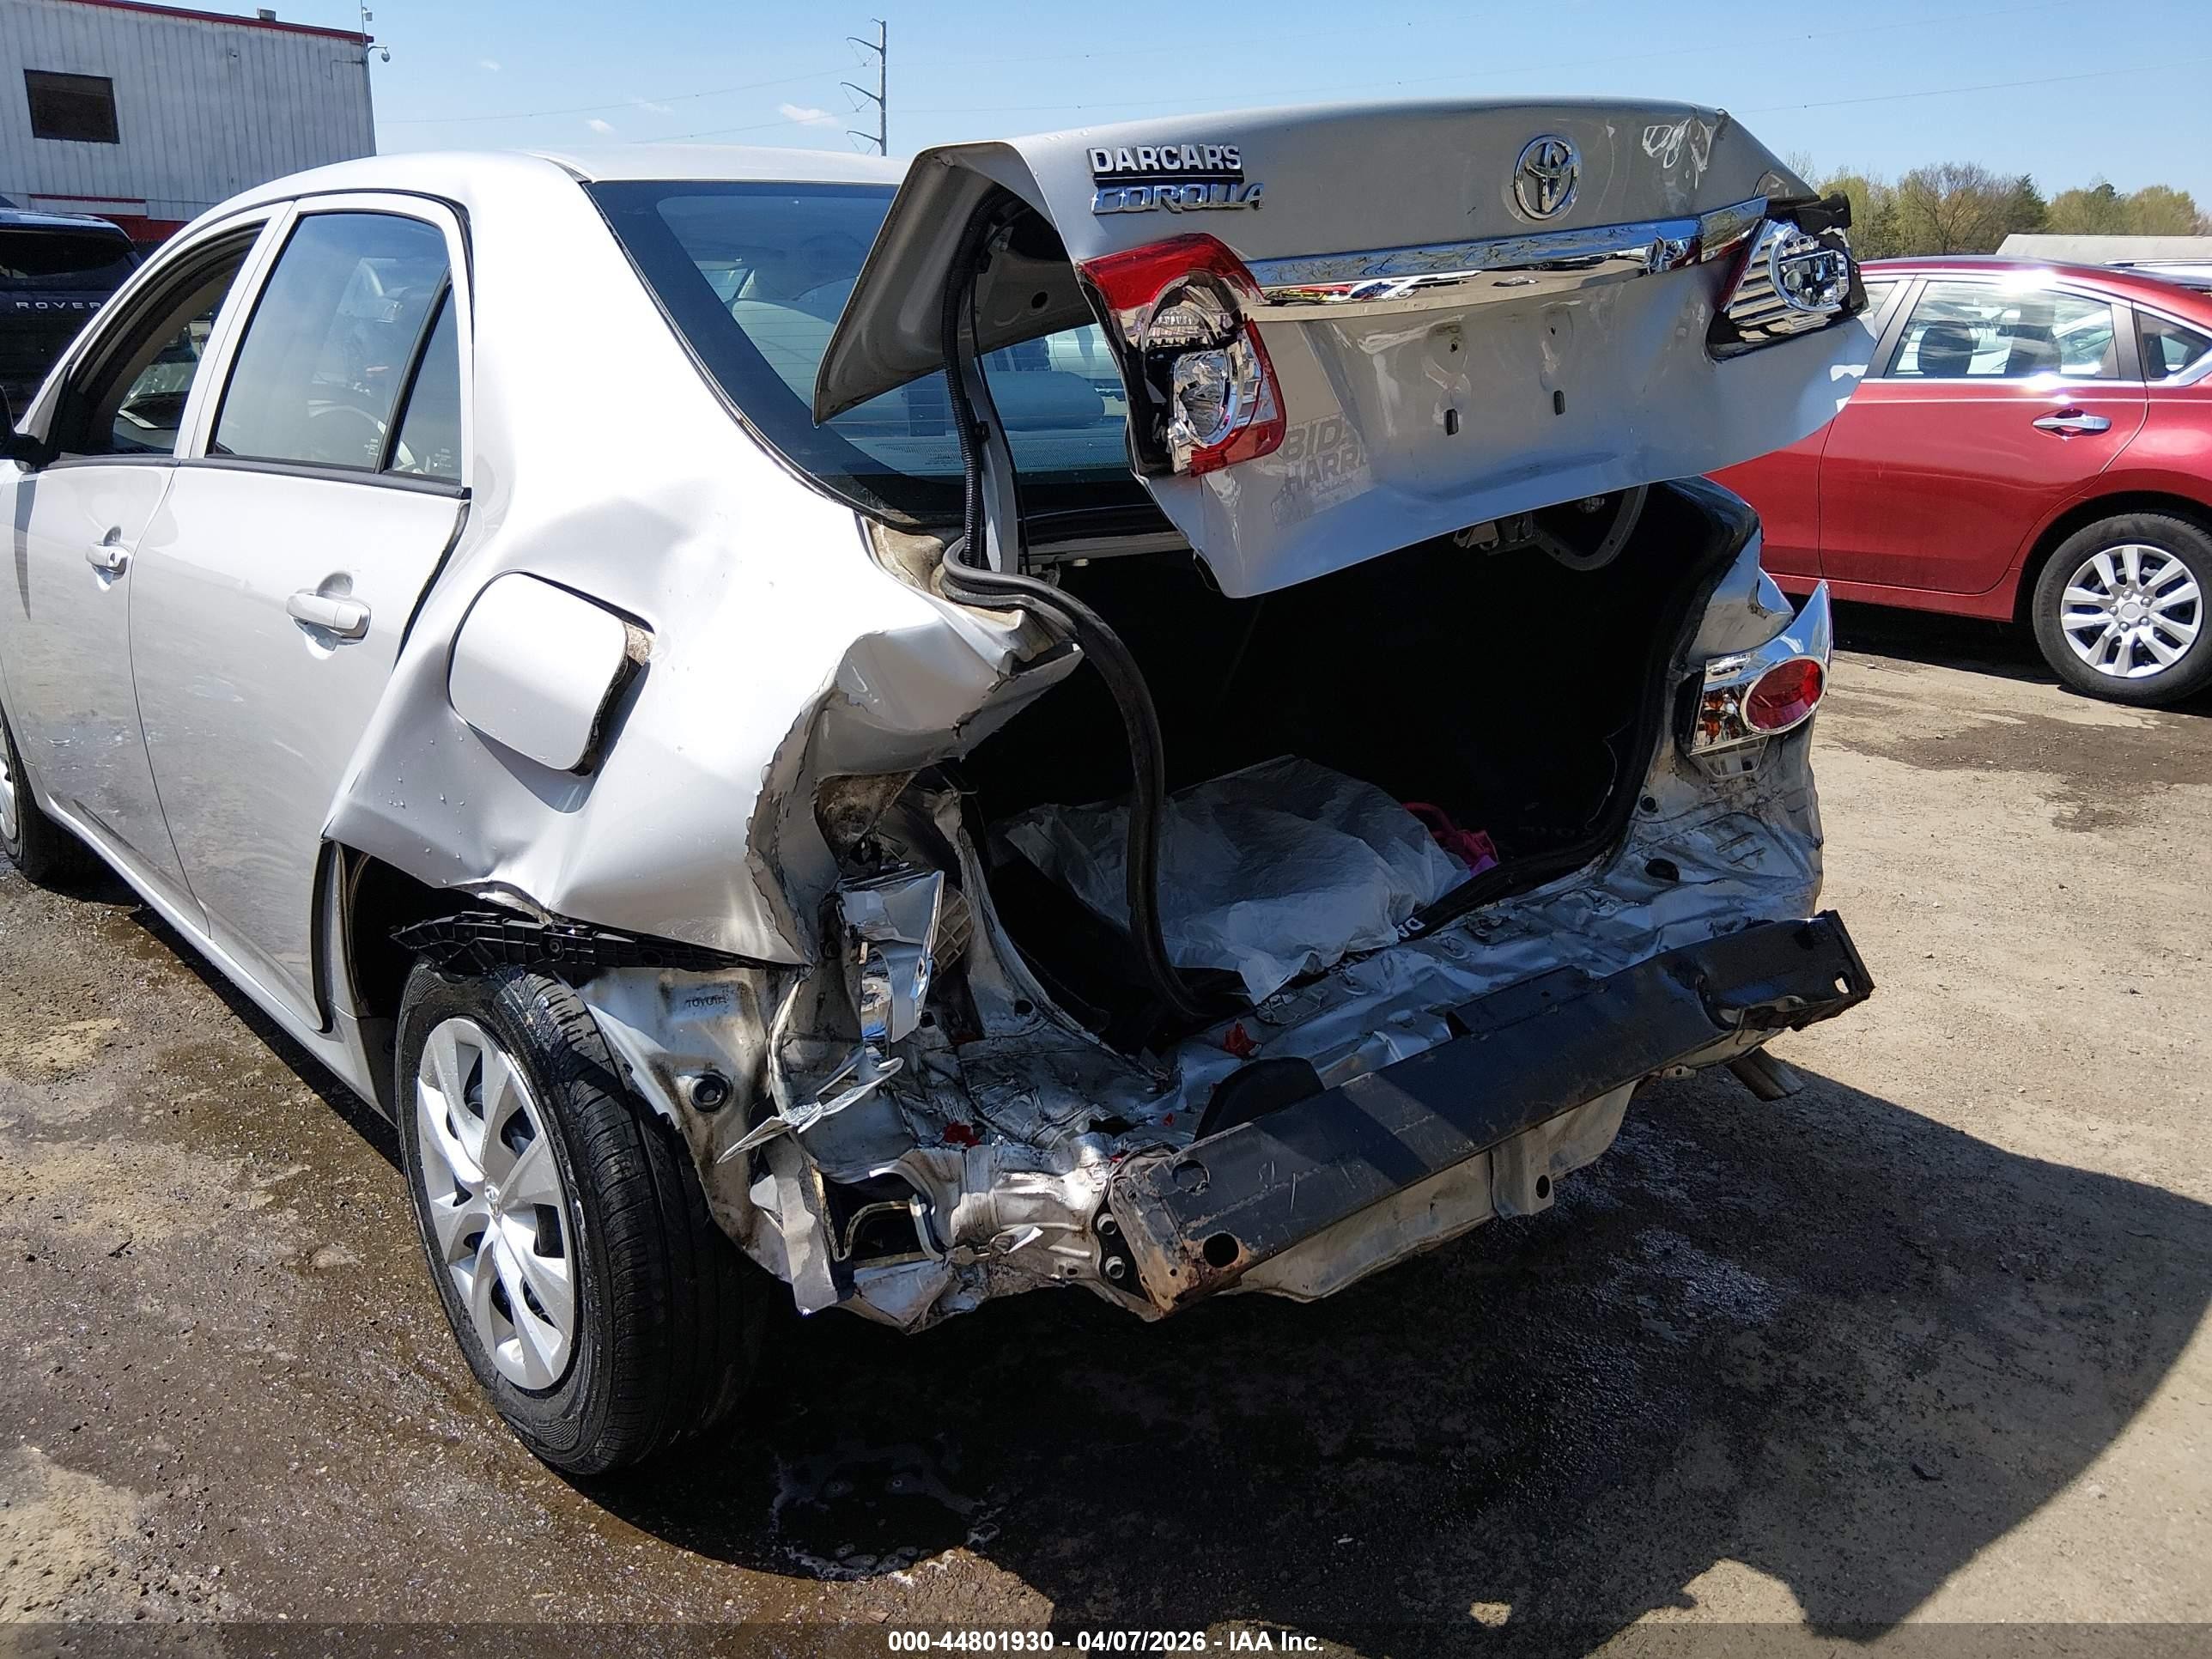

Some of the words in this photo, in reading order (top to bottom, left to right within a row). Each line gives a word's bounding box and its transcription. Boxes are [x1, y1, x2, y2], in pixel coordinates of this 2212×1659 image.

[1088, 144, 1243, 173] DARCARS
[1091, 182, 1265, 214] COROLLA
[1282, 418, 1343, 463] BID
